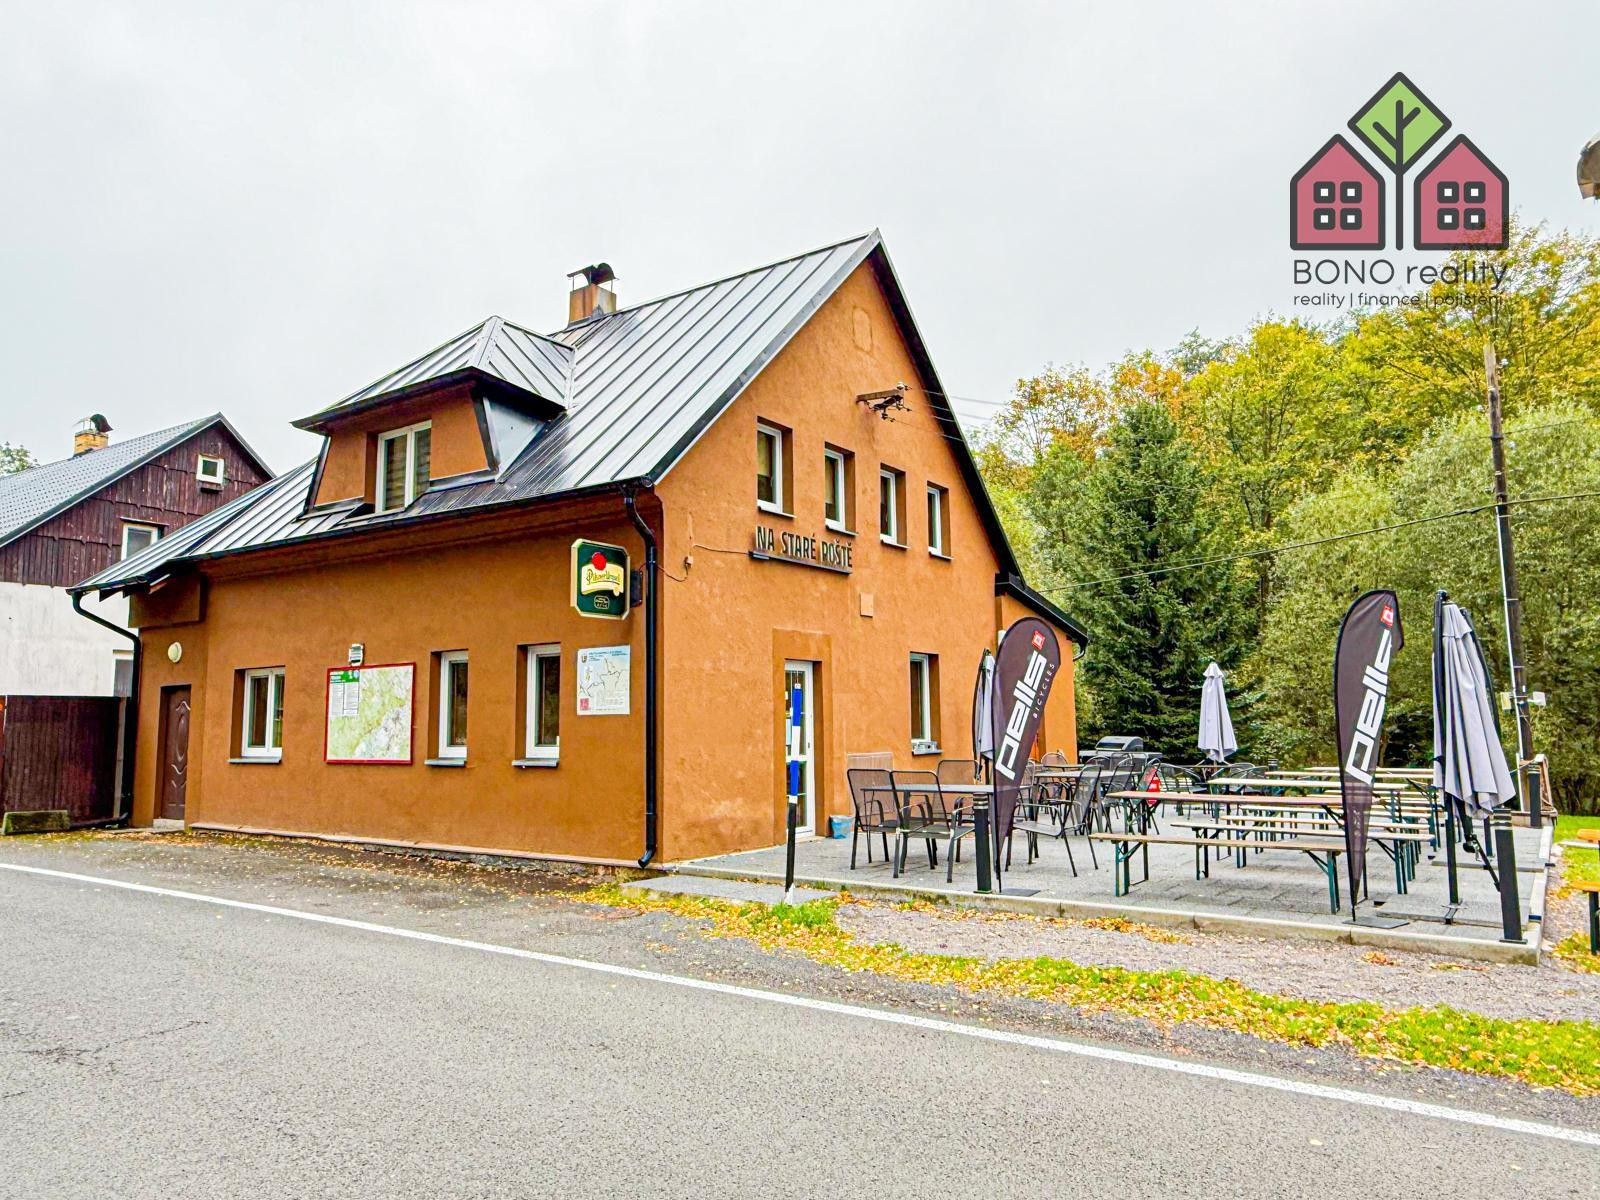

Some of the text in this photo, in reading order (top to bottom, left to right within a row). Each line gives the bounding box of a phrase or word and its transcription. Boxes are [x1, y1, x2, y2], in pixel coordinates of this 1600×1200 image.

[755, 526, 853, 568] NA STARÉ POŠTĚ
[995, 651, 1047, 781] pells
[1032, 663, 1056, 719] BICYCLES
